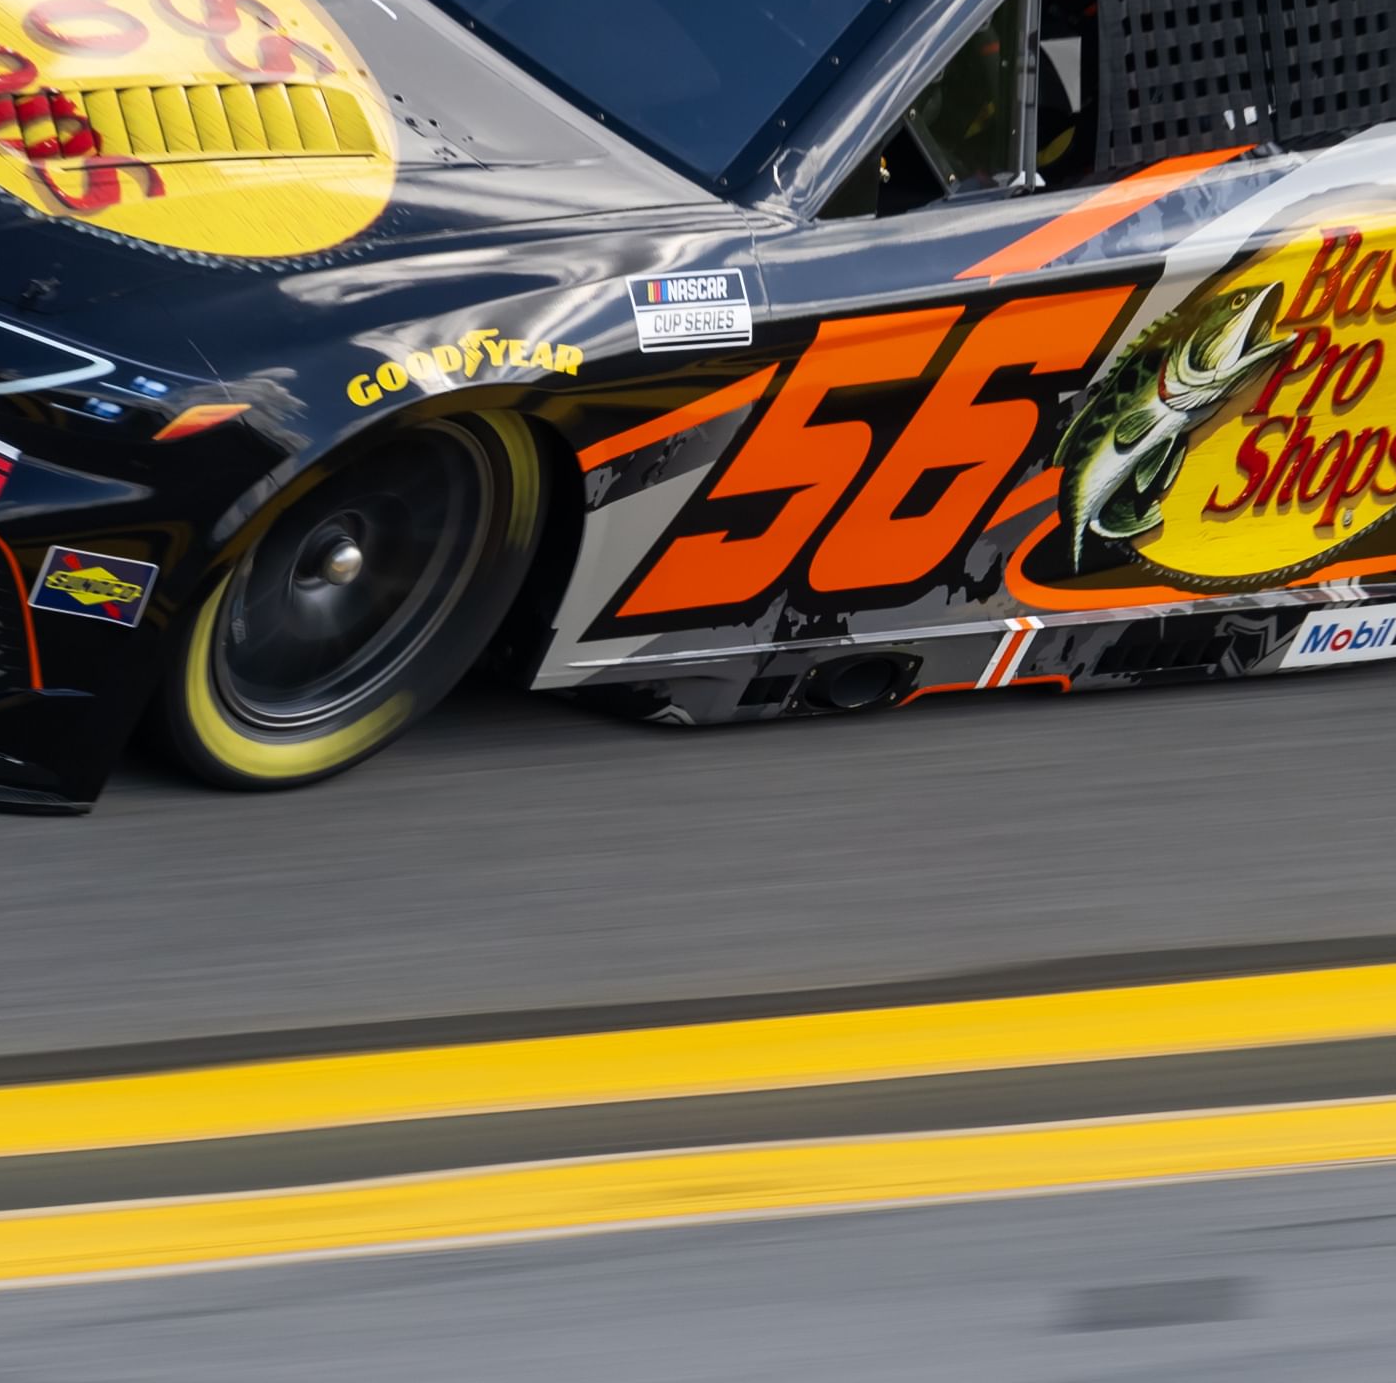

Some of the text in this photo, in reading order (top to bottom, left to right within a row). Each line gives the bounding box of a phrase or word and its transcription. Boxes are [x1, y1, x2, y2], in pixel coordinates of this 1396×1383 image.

[667, 276, 728, 302] NASCAR
[654, 308, 735, 334] CUP SERIES
[1242, 324, 1385, 418] Pro
[616, 284, 1138, 618] 56
[1299, 617, 1396, 655] Mobil
